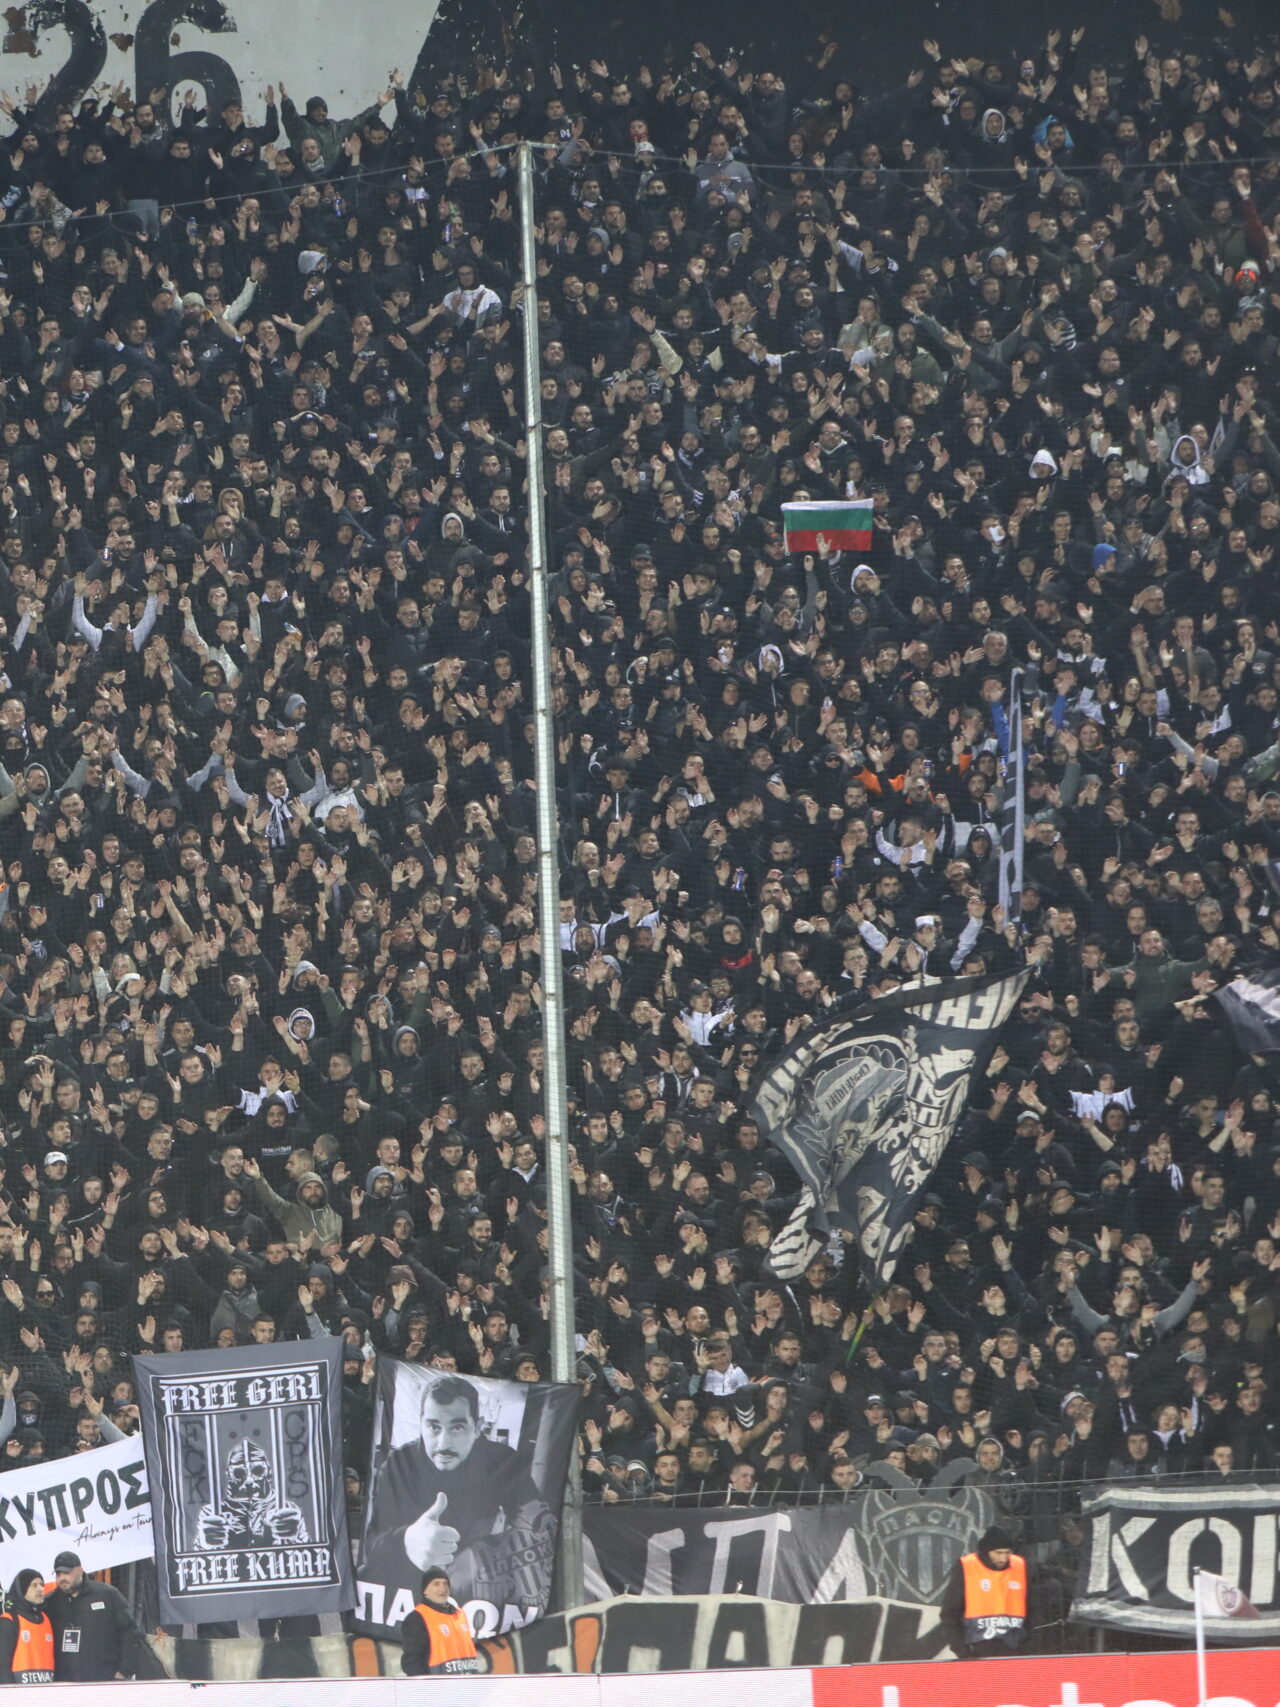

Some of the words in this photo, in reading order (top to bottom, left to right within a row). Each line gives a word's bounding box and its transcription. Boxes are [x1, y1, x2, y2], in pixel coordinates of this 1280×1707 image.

[160, 1380, 239, 1415] FREE
[74, 1523, 119, 1547] Always
[175, 1553, 241, 1592] FREE
[247, 1547, 331, 1581] KUMA
[355, 1580, 539, 1639] ΠΑΩΝ
[21, 1671, 54, 1684] STEWA
